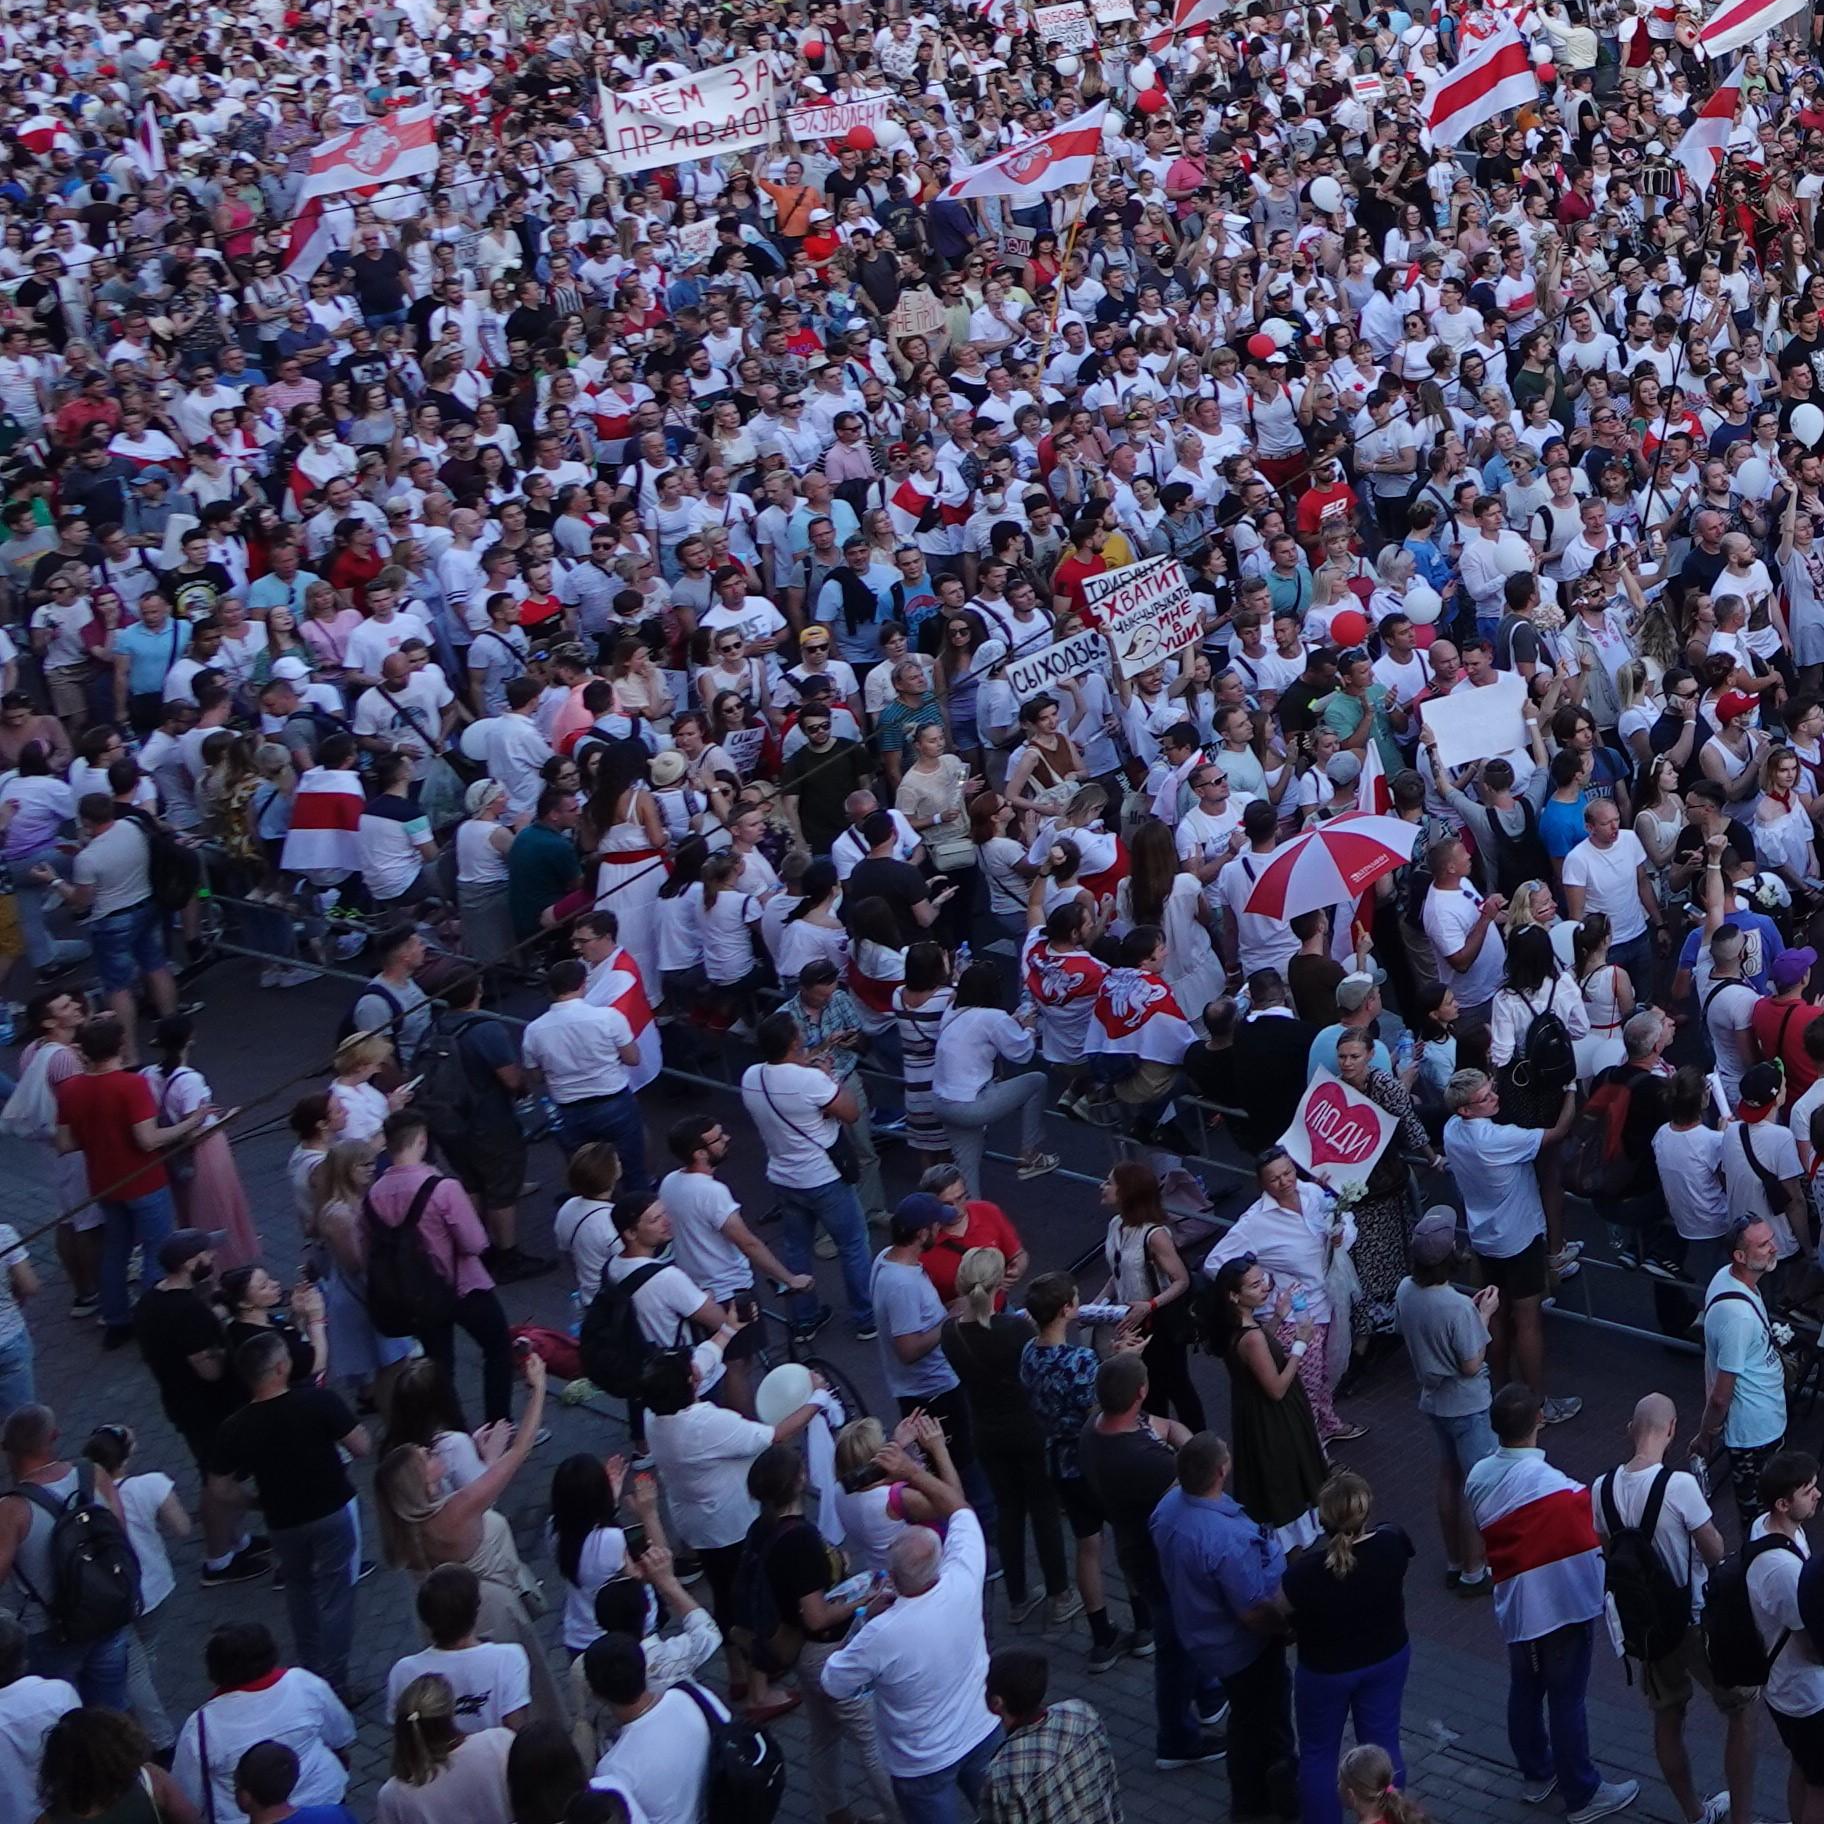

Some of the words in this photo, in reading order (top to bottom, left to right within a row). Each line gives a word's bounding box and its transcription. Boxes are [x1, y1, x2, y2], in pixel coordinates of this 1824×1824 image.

[725, 58, 769, 101] ЗА
[1103, 564, 1181, 623] ХВАТИТ
[1157, 600, 1191, 630] МНЕ
[1161, 622, 1201, 653] УШИ
[1173, 621, 1181, 632] В
[1012, 633, 1107, 693] СЫХОДЗЬ!
[1306, 1099, 1372, 1161] ЛЮДИ
